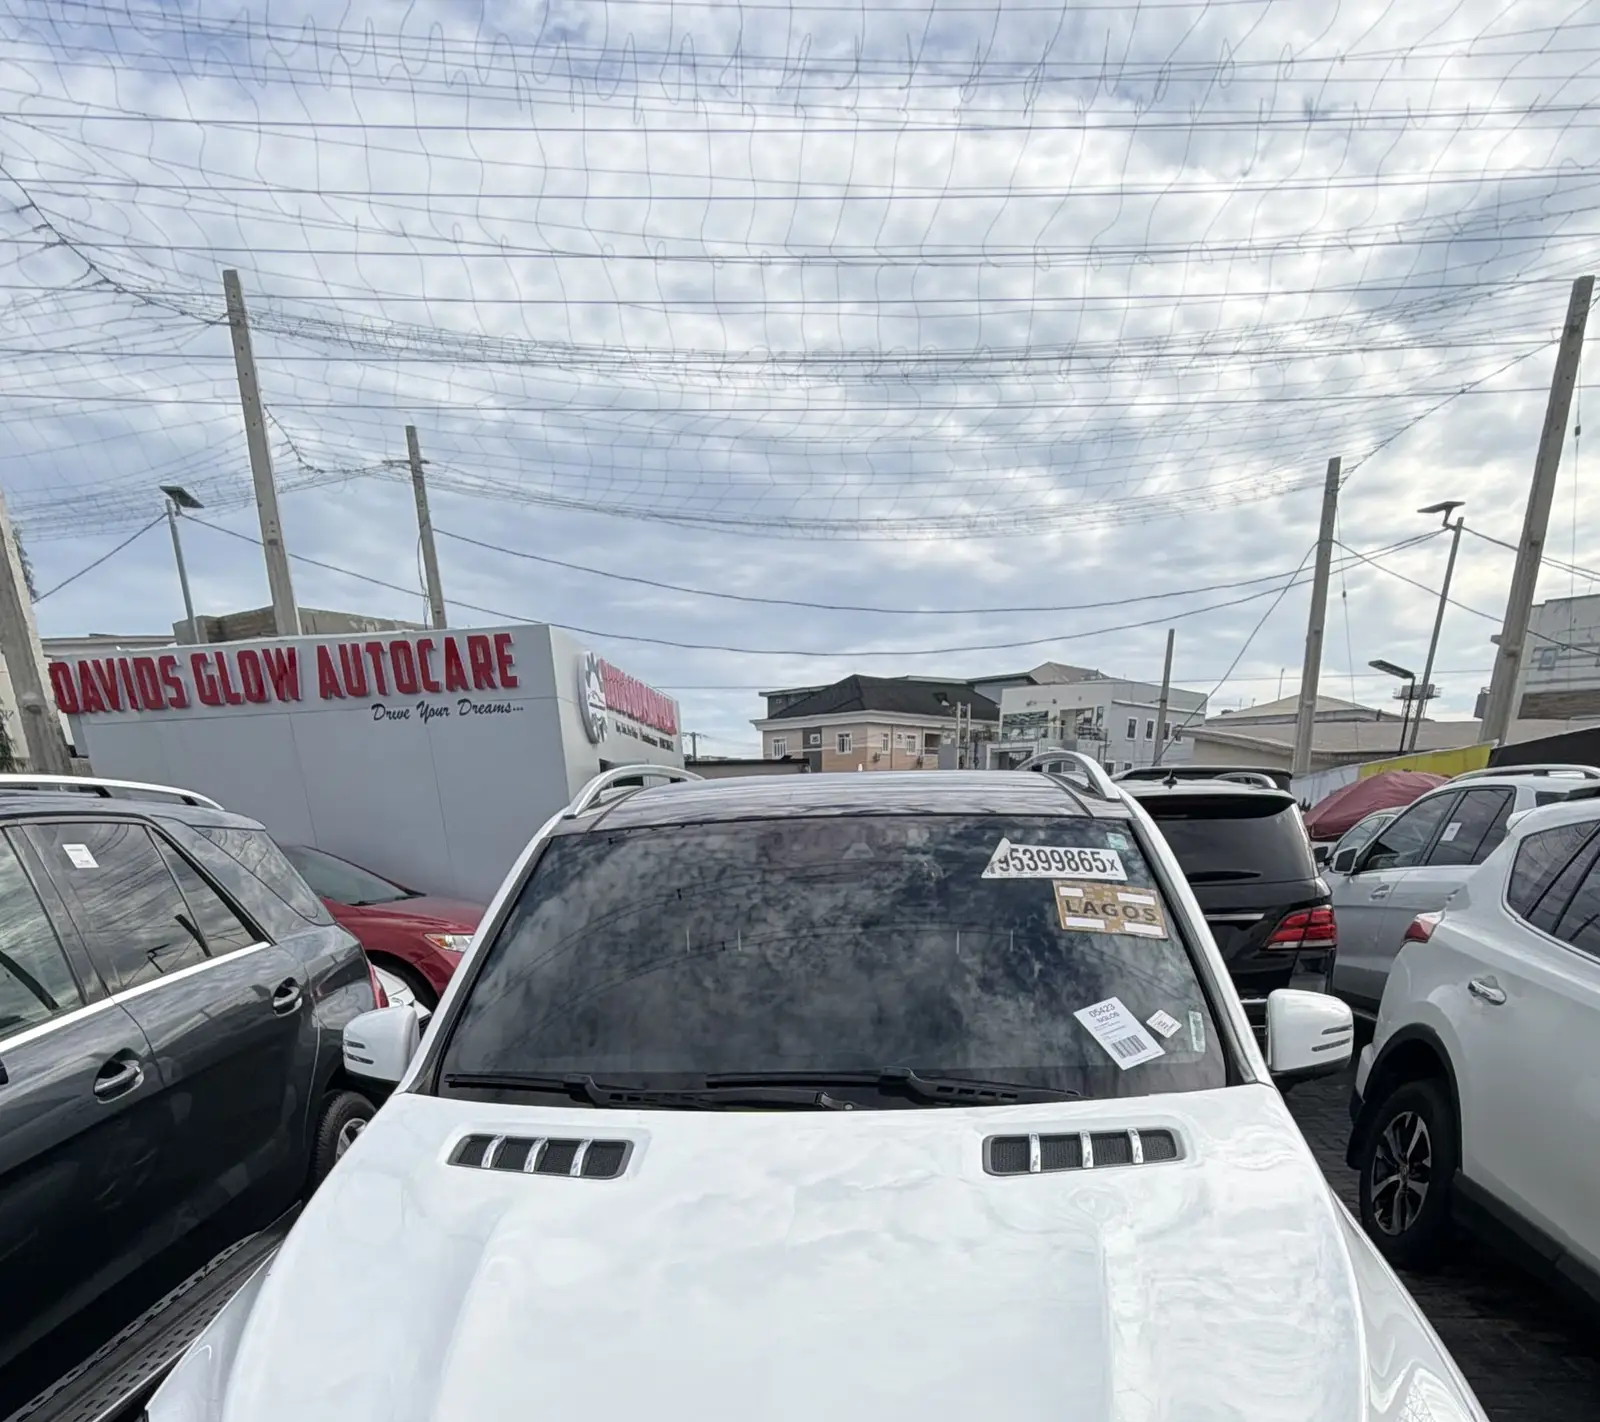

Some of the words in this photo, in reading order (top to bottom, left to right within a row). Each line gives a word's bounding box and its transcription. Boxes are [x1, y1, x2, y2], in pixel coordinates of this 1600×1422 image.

[48, 655, 190, 714] DAVIDS
[190, 646, 302, 706] GLOW
[316, 633, 519, 699] AUTOCARE
[371, 703, 410, 721] Drive
[417, 700, 450, 724] Your
[1065, 900, 1156, 921] LAGOS
[1088, 1003, 1115, 1018] 05423
